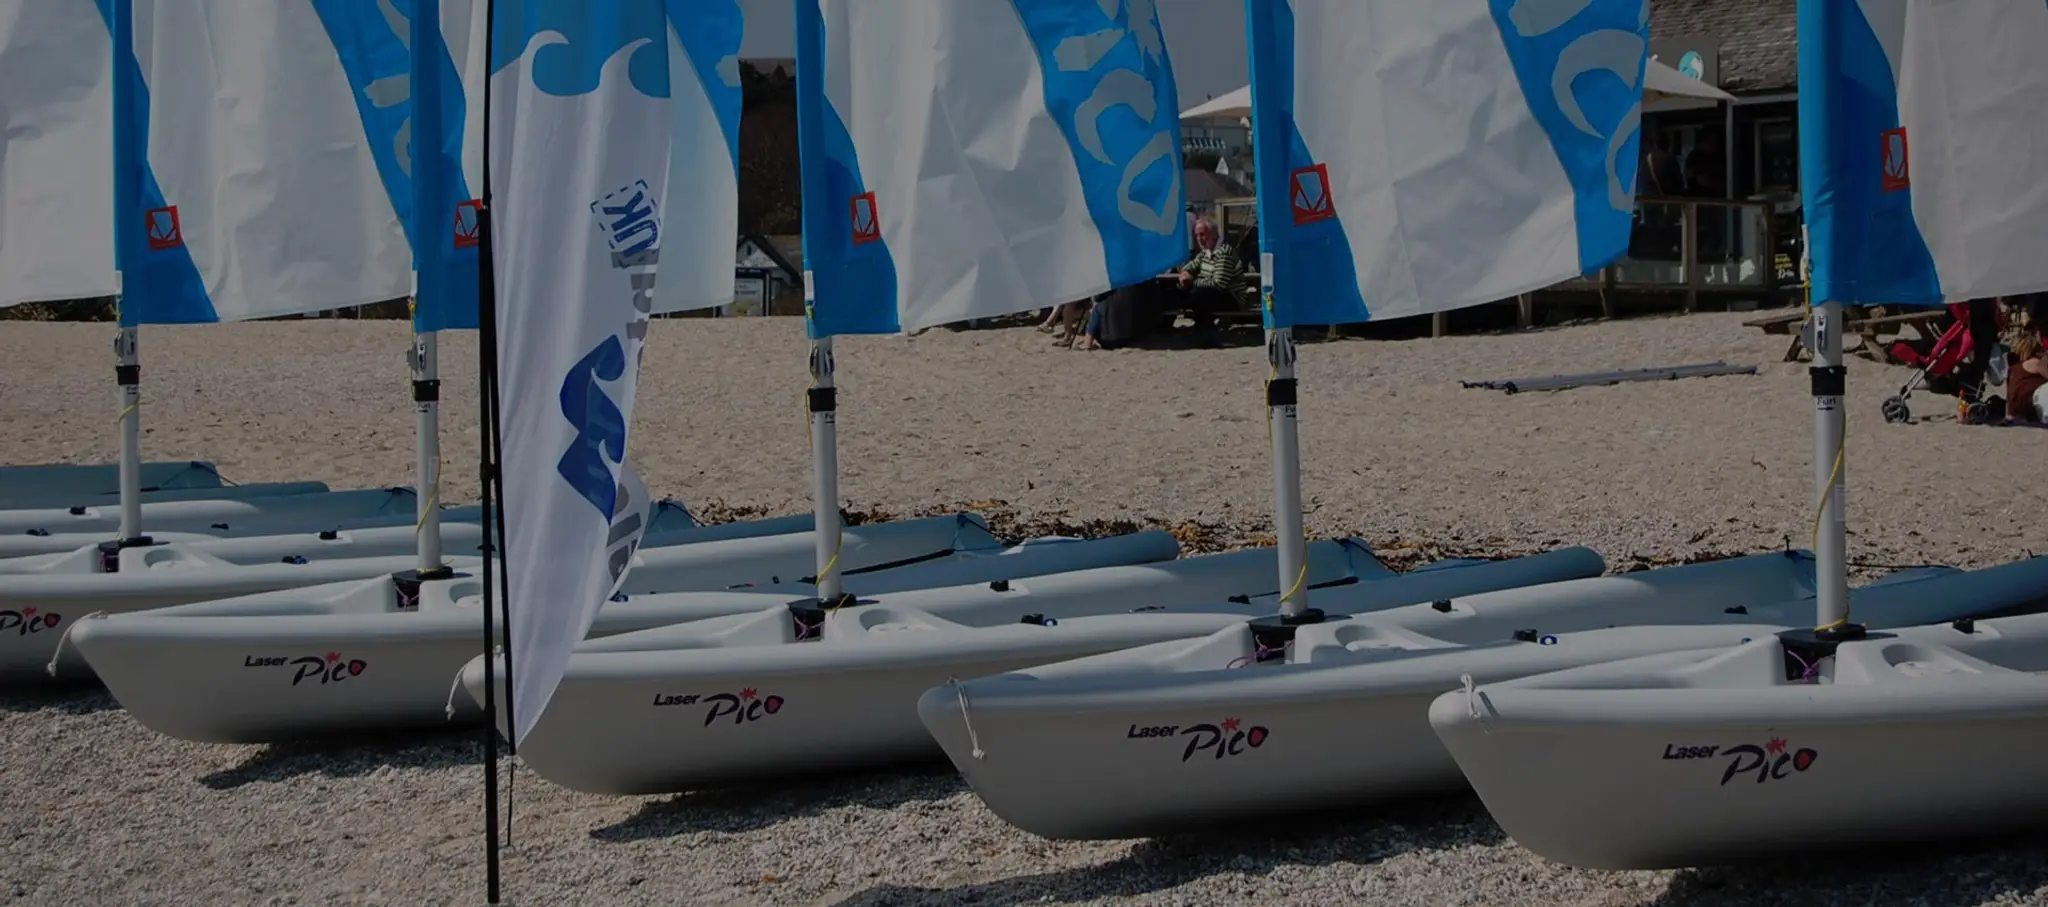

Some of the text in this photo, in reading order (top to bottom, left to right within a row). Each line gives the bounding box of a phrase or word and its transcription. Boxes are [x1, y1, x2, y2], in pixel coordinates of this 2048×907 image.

[602, 190, 659, 258] UK
[244, 651, 367, 686] Laser Pico
[653, 687, 784, 727] Laser Pico
[1127, 717, 1269, 763] Laser Pico
[1662, 736, 1818, 787] Laser Pico
